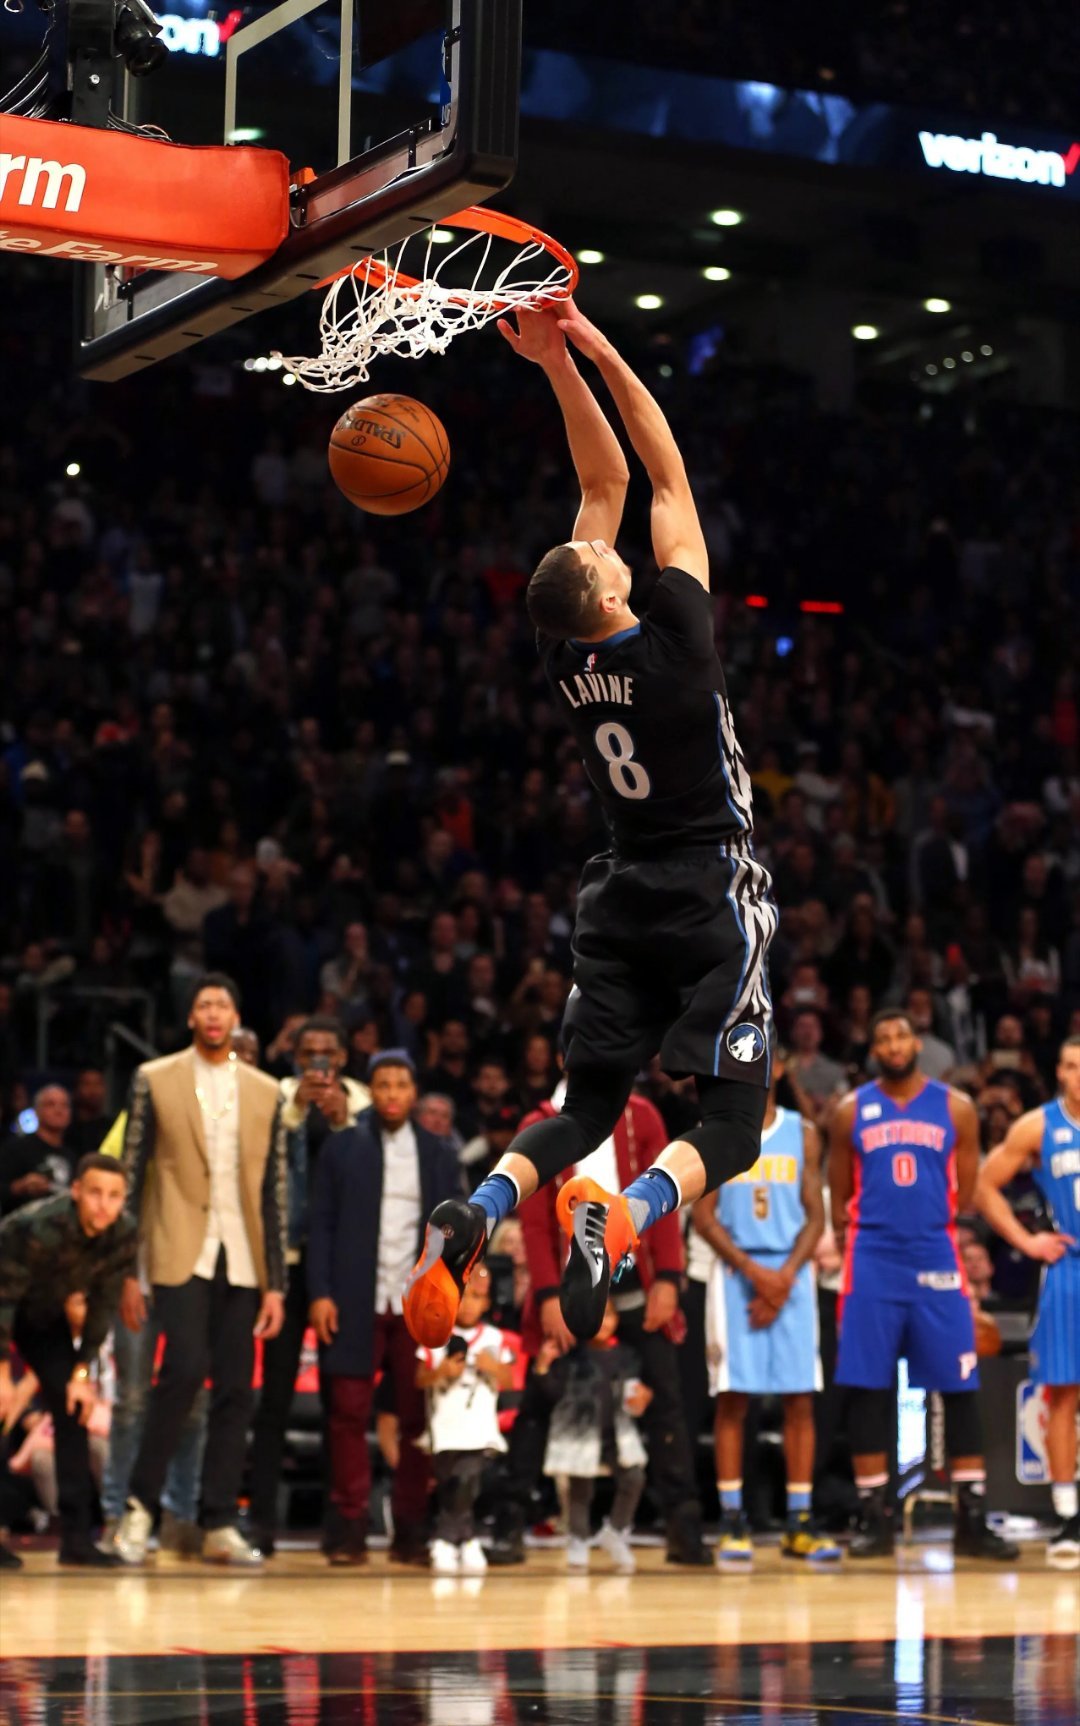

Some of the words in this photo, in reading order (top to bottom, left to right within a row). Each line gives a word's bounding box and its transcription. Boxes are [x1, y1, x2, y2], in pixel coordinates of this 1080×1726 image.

[918, 130, 1066, 188] verizon
[0, 153, 87, 212] rm
[35, 240, 218, 272] Farm
[336, 414, 404, 449] SPALD
[559, 673, 634, 709] LAVINE
[595, 722, 651, 800] 8
[892, 1152, 918, 1187] 0
[753, 1185, 769, 1221] 5
